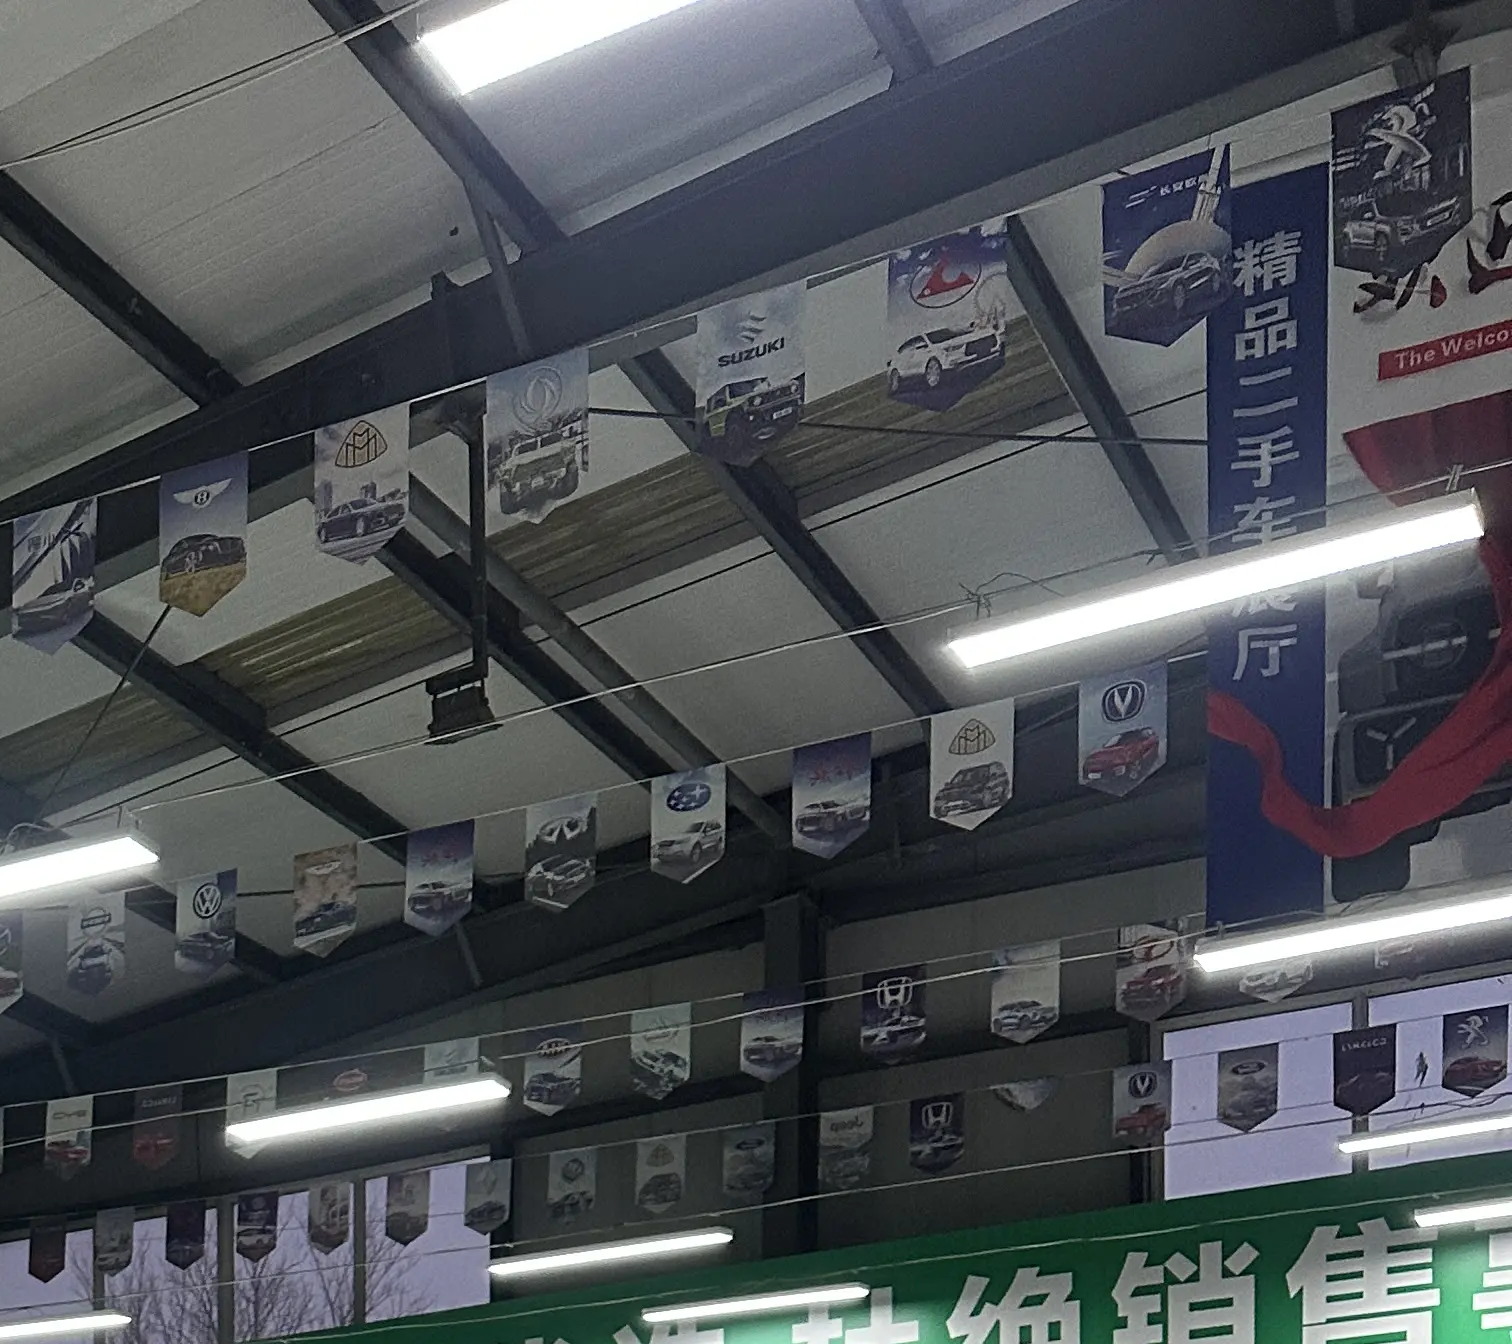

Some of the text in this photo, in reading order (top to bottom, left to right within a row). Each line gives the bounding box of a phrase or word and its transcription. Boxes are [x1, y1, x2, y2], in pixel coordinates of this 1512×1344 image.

[717, 337, 786, 368] SUZUKI
[1395, 328, 1512, 370] The Welco
[1230, 230, 1302, 682] 精品二手车厅
